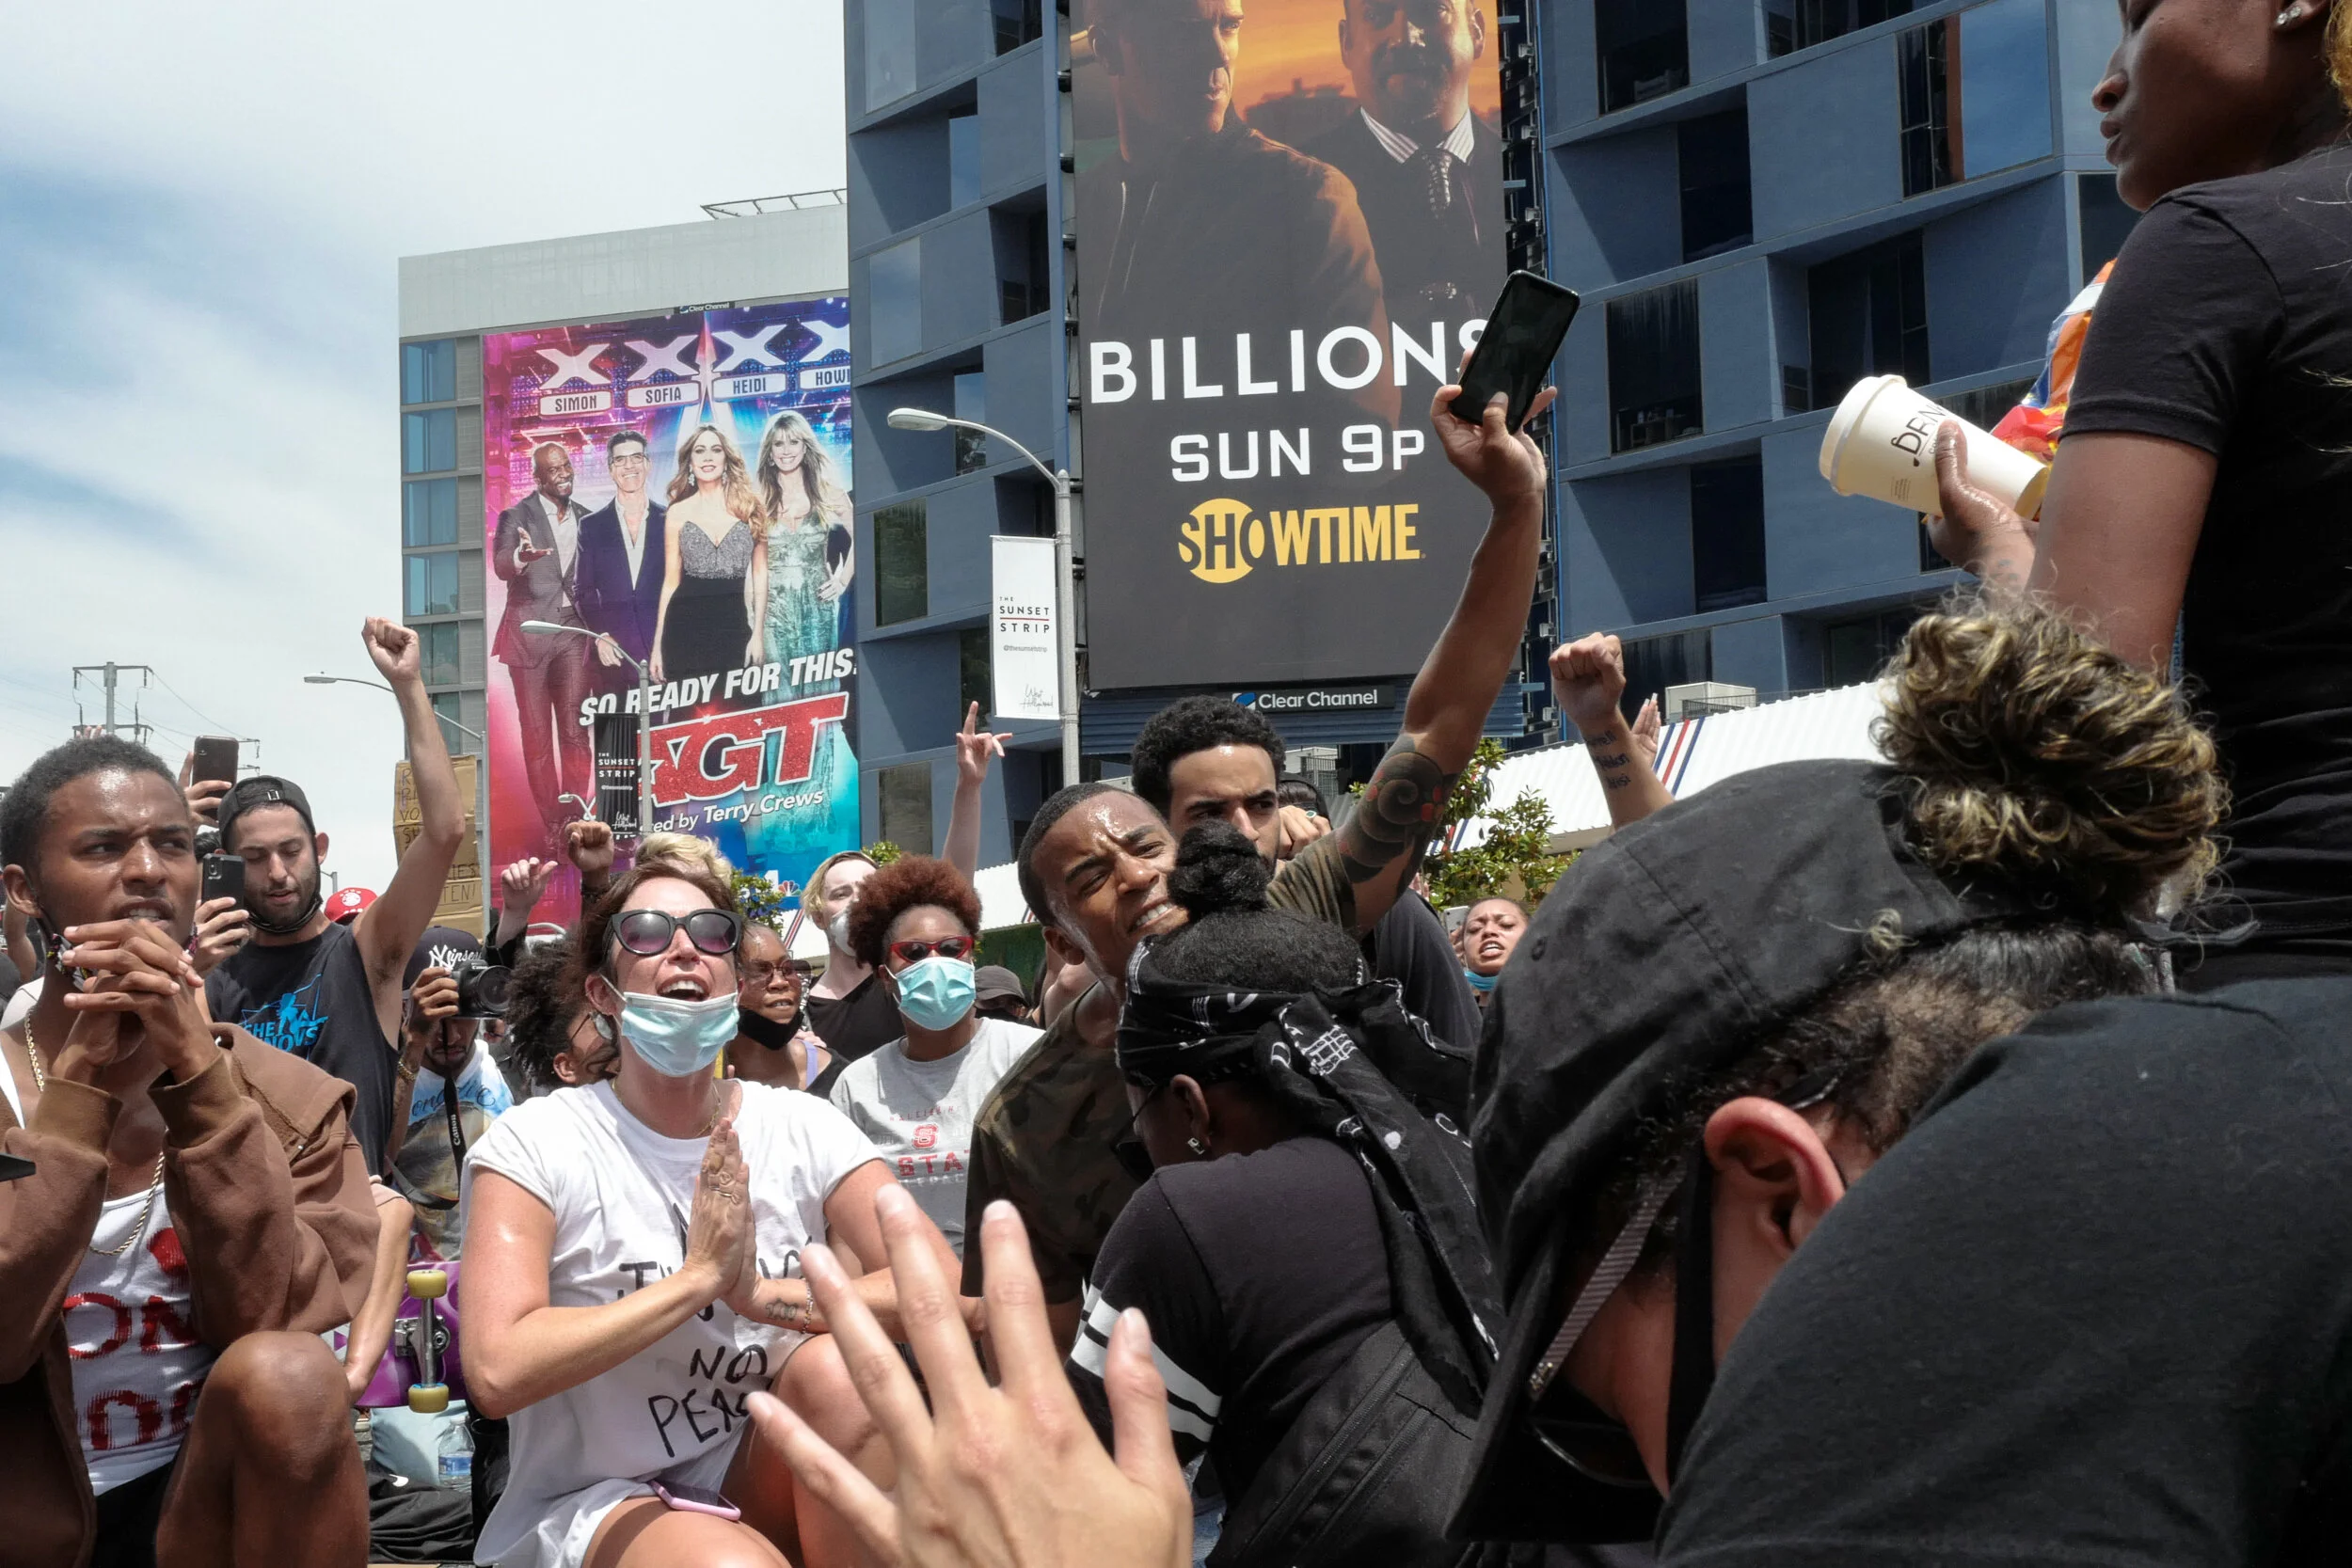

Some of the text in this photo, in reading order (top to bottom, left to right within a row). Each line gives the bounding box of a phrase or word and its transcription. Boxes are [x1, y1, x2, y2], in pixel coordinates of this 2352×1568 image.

[705, 302, 730, 310] Channel
[733, 377, 767, 395] HEIDI
[816, 368, 850, 387] HOWI
[555, 395, 597, 413] SIMON
[645, 387, 682, 404] SOFIA
[1170, 423, 1425, 483] SUN 9P
[1178, 498, 1421, 584] SHOWTIME
[999, 605, 1050, 616] SUNSET
[1000, 623, 1050, 634] STRIP
[580, 692, 617, 726] SO
[625, 673, 721, 715] READY
[723, 661, 782, 700] FOR
[1258, 689, 1378, 709] Clear Channel
[598, 769, 636, 778] STRIP
[678, 812, 700, 832] by
[703, 801, 755, 824] Terry
[759, 790, 824, 814] Crews
[453, 1114, 461, 1146] Canon
[898, 1149, 971, 1177] STA
[689, 1343, 769, 1385] NO
[647, 1387, 750, 1458] PEAC
